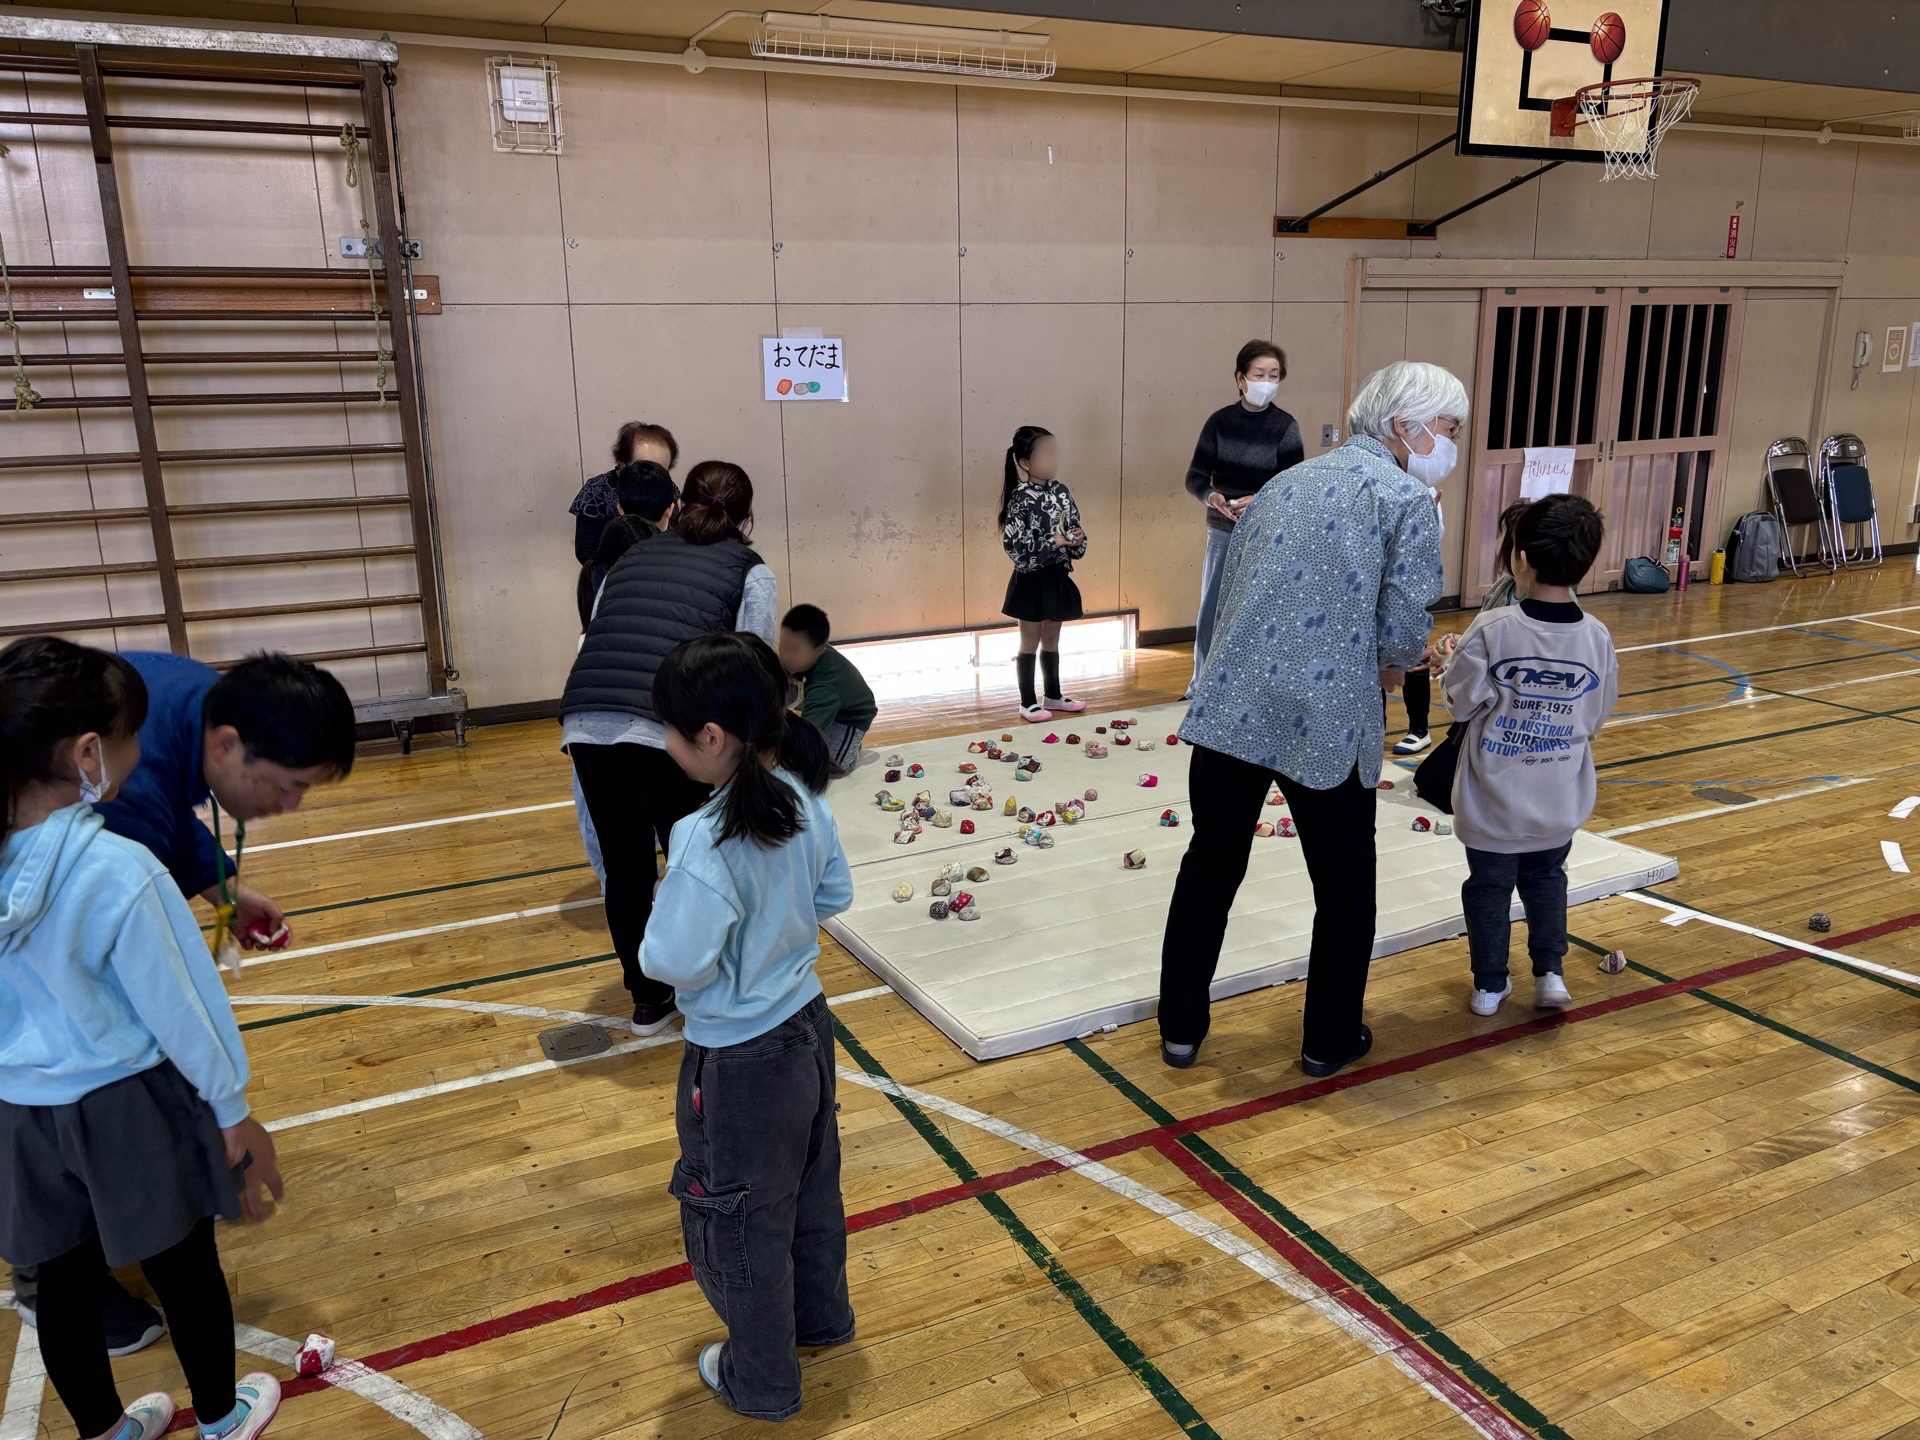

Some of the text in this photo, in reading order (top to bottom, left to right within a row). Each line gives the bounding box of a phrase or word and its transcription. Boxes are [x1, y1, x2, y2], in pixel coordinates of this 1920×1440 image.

[774, 342, 840, 369] おてだま
[1504, 666, 1587, 688] nev
[1512, 699, 1573, 715] SURF-1975
[1529, 711, 1552, 722] 23st
[1495, 715, 1574, 737] OLD AUSTRALIA
[1526, 738, 1571, 753] SHAPES
